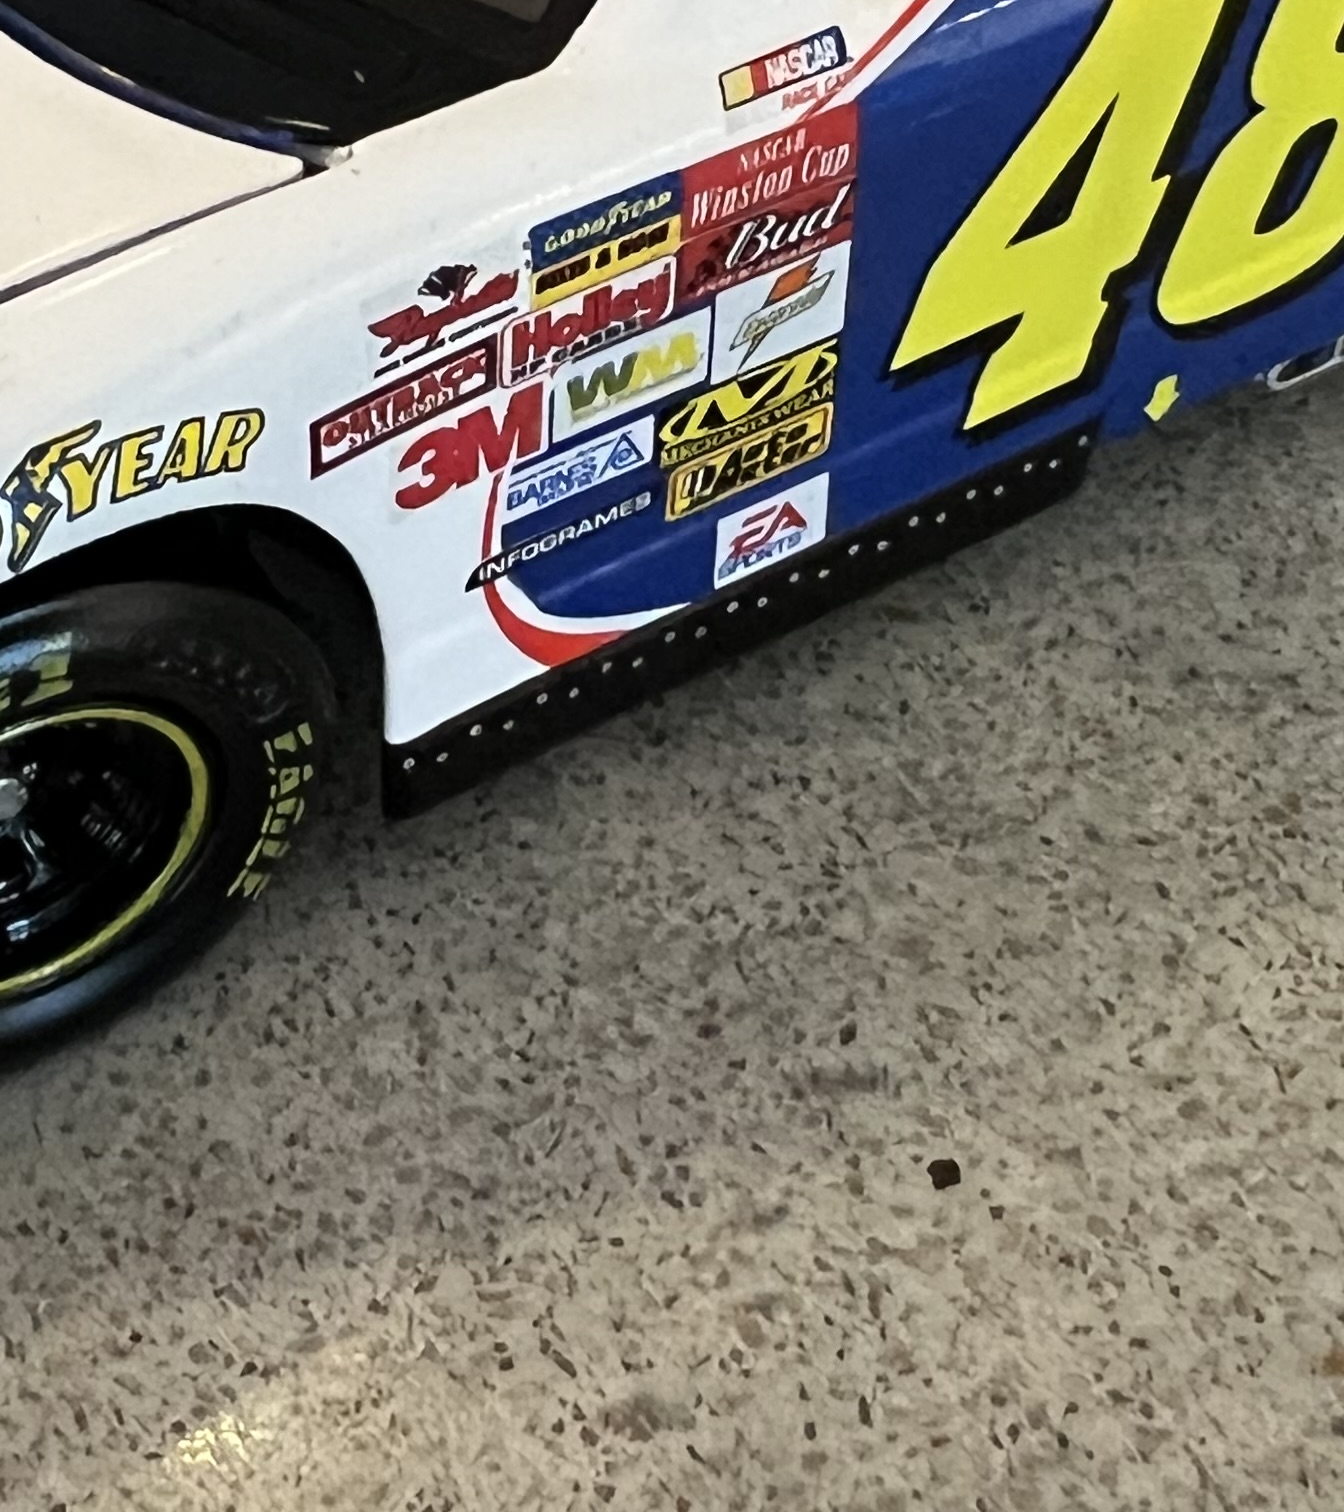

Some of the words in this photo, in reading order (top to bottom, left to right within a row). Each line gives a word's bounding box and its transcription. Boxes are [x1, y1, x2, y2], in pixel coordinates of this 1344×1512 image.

[691, 166, 794, 228] Winston
[802, 144, 850, 183] Cup
[726, 183, 851, 269] Bud
[512, 267, 670, 367] Holley
[394, 383, 542, 510] 3M
[729, 501, 809, 558] EA
